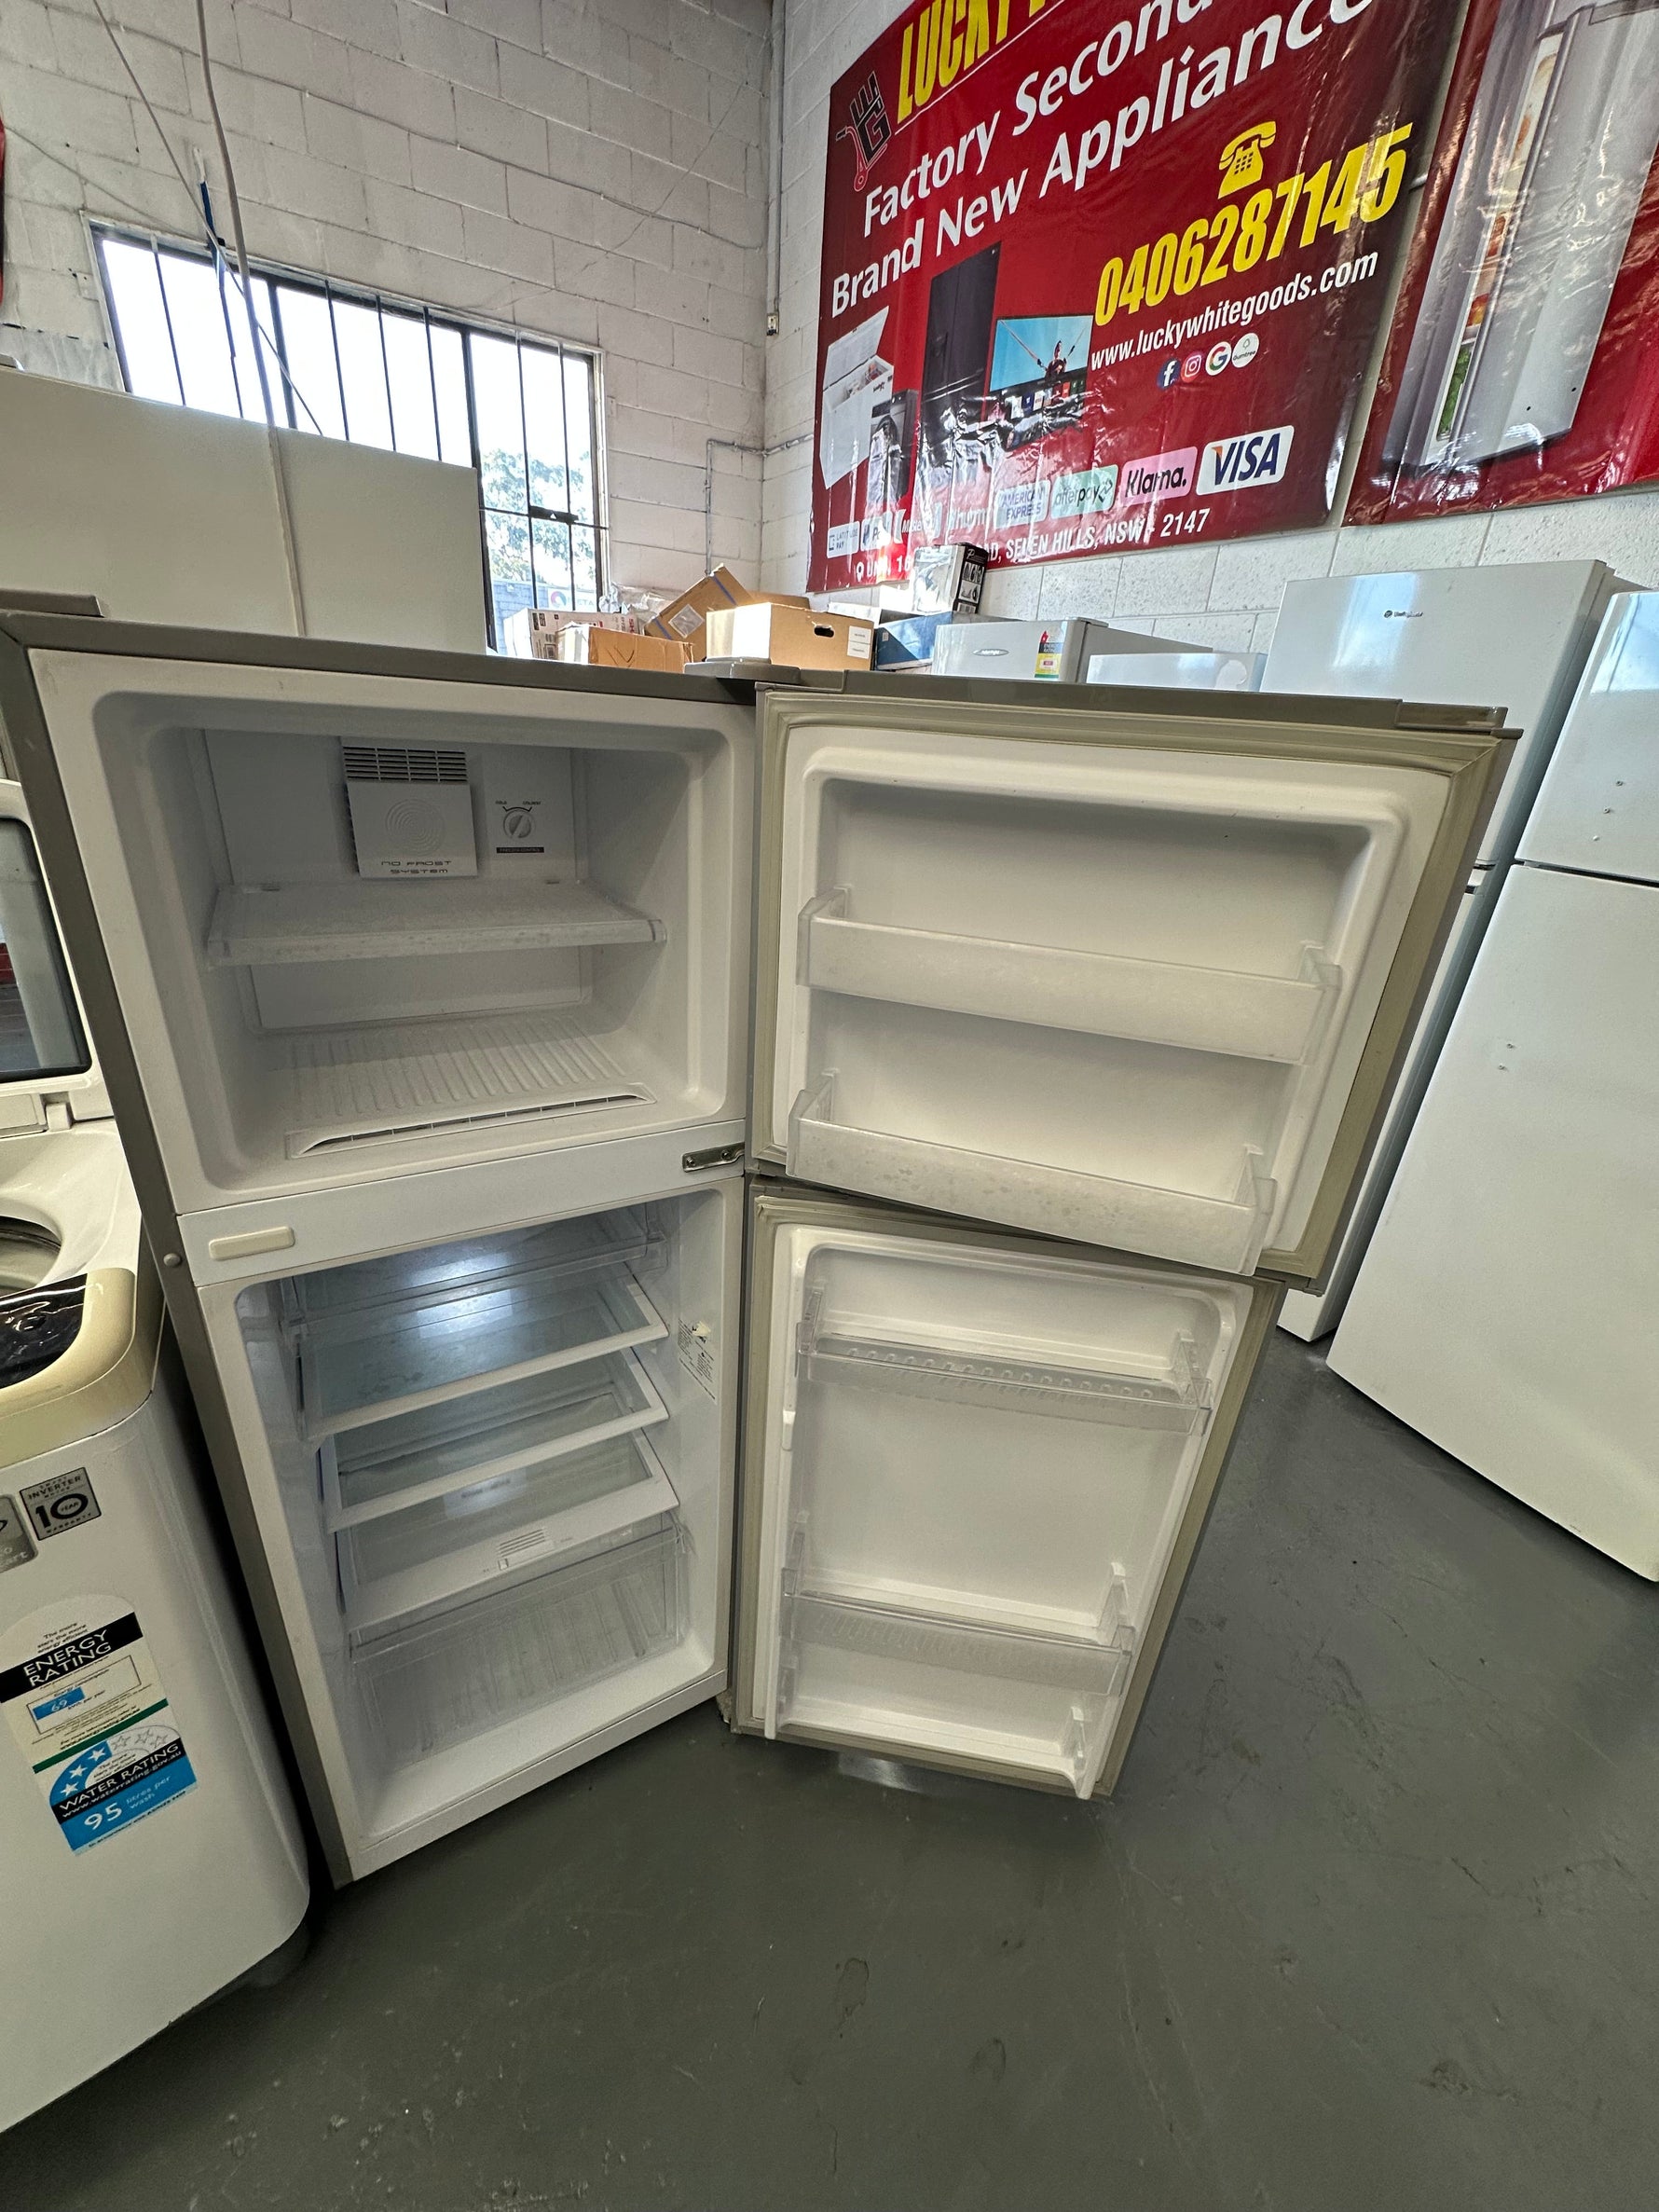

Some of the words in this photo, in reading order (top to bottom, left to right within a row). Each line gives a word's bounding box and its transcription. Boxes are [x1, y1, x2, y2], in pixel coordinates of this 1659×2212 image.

[865, 110, 1000, 238] Factory
[832, 217, 925, 318] Brand
[937, 168, 1028, 257] New
[1094, 122, 1413, 327] 0406287145
[1091, 252, 1378, 371] www.luckywhitegoods.com
[1212, 433, 1282, 487] VISA
[1006, 502, 1042, 520] EXPRES
[1159, 508, 1211, 539] 2147
[28, 1476, 81, 1500] INVERTER
[35, 1493, 89, 1529] 10
[23, 1629, 107, 1676] ENERGY
[29, 1642, 112, 1687] RATING
[59, 1779, 117, 1810] WATER
[120, 1743, 179, 1779] RATING
[62, 1751, 182, 1818] www.waterrating.gov.au
[84, 1802, 122, 1830] 95
